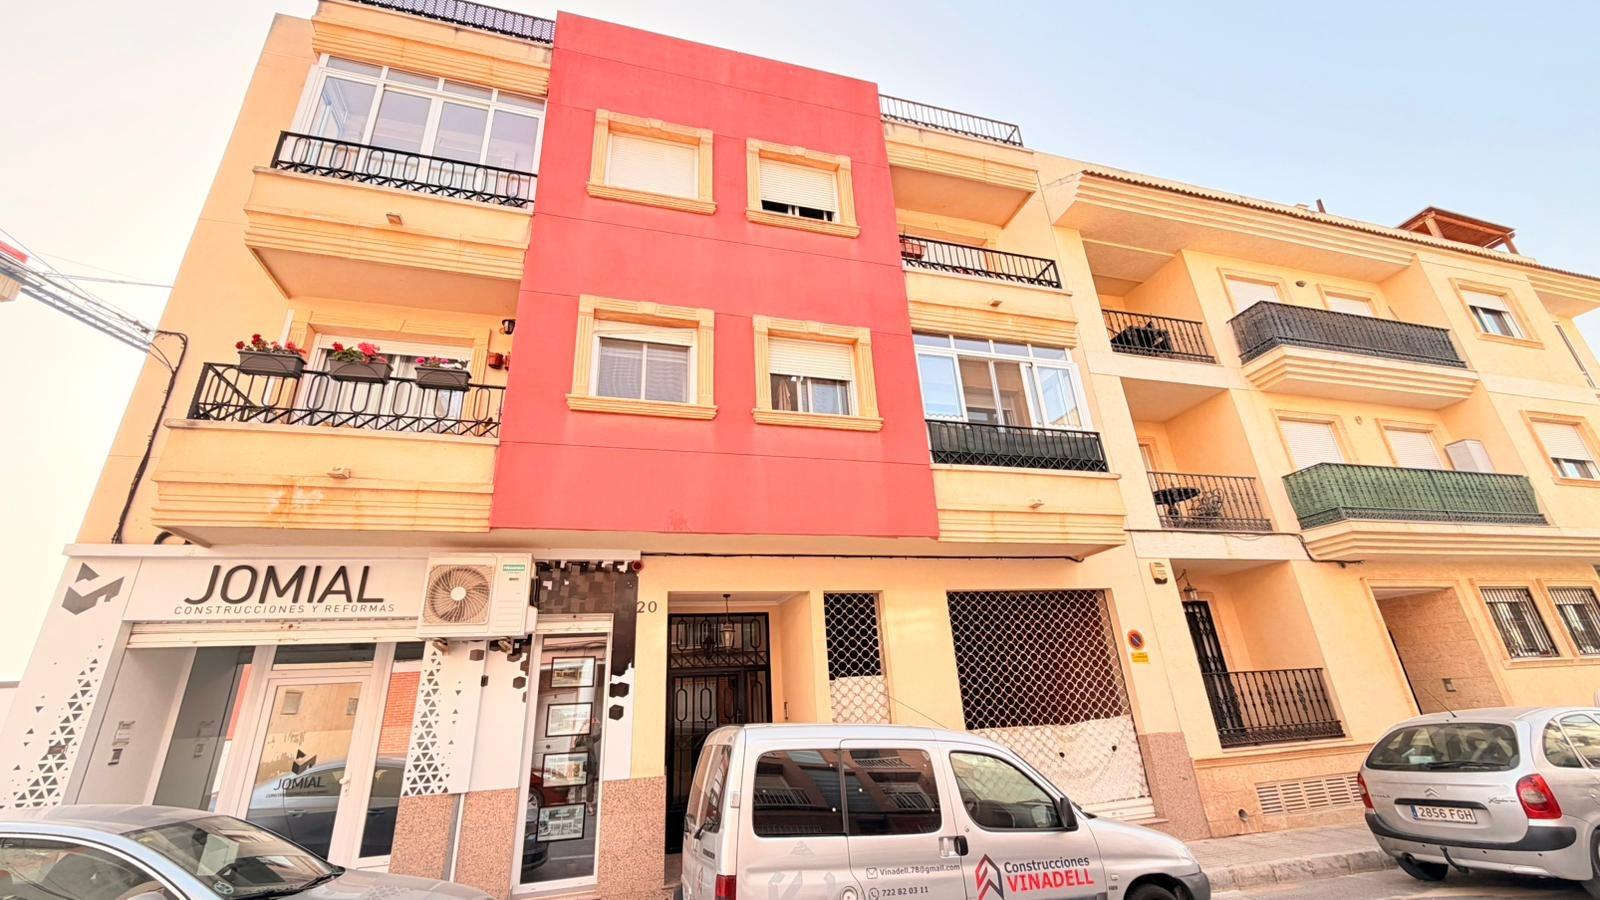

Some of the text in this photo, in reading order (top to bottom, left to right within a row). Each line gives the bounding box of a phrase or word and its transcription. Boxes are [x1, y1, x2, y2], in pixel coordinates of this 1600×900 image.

[184, 564, 384, 605] JOMIAL
[174, 603, 395, 615] CONSTRUCCIONES Y REFORMAS
[636, 600, 657, 613] 20
[273, 776, 326, 791] JOMIAL
[1418, 806, 1473, 820] 2856 FGH
[1004, 856, 1090, 873] Construcciones
[1006, 868, 1095, 892] VINADELL
[882, 888, 896, 897] 722
